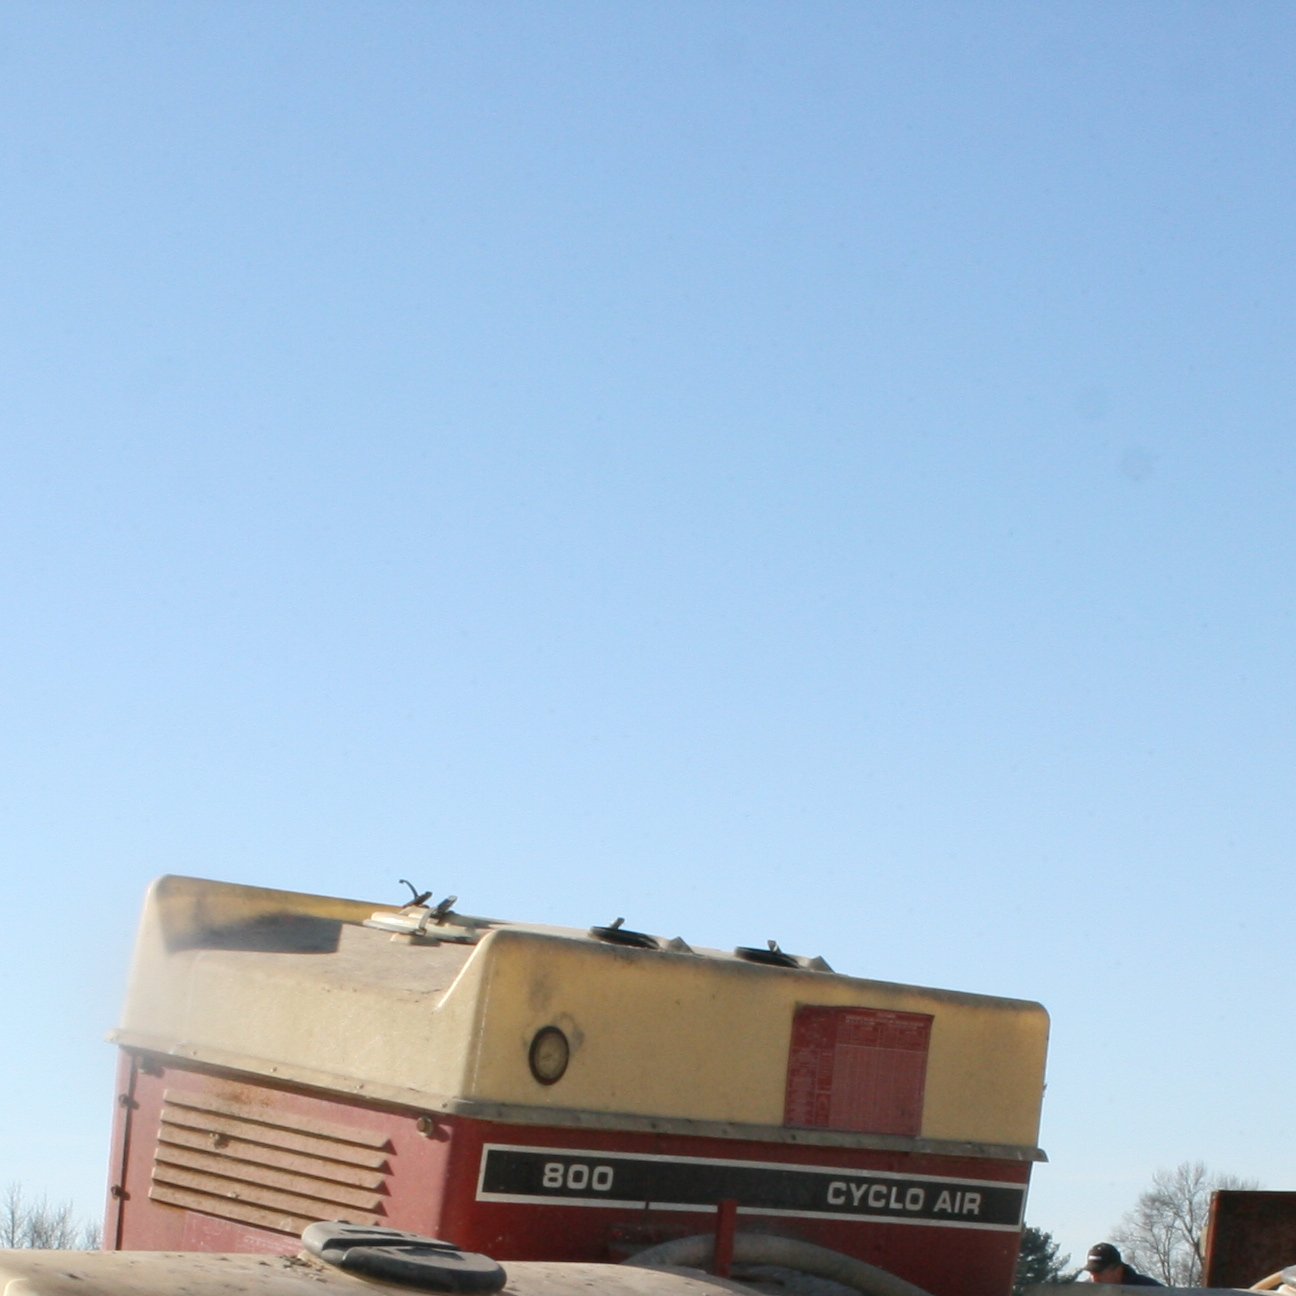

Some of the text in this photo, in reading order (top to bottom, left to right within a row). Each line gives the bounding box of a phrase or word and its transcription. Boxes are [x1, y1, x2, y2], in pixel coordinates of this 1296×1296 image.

[543, 1162, 614, 1191] 800
[826, 1181, 982, 1216] CYCLO AIR
